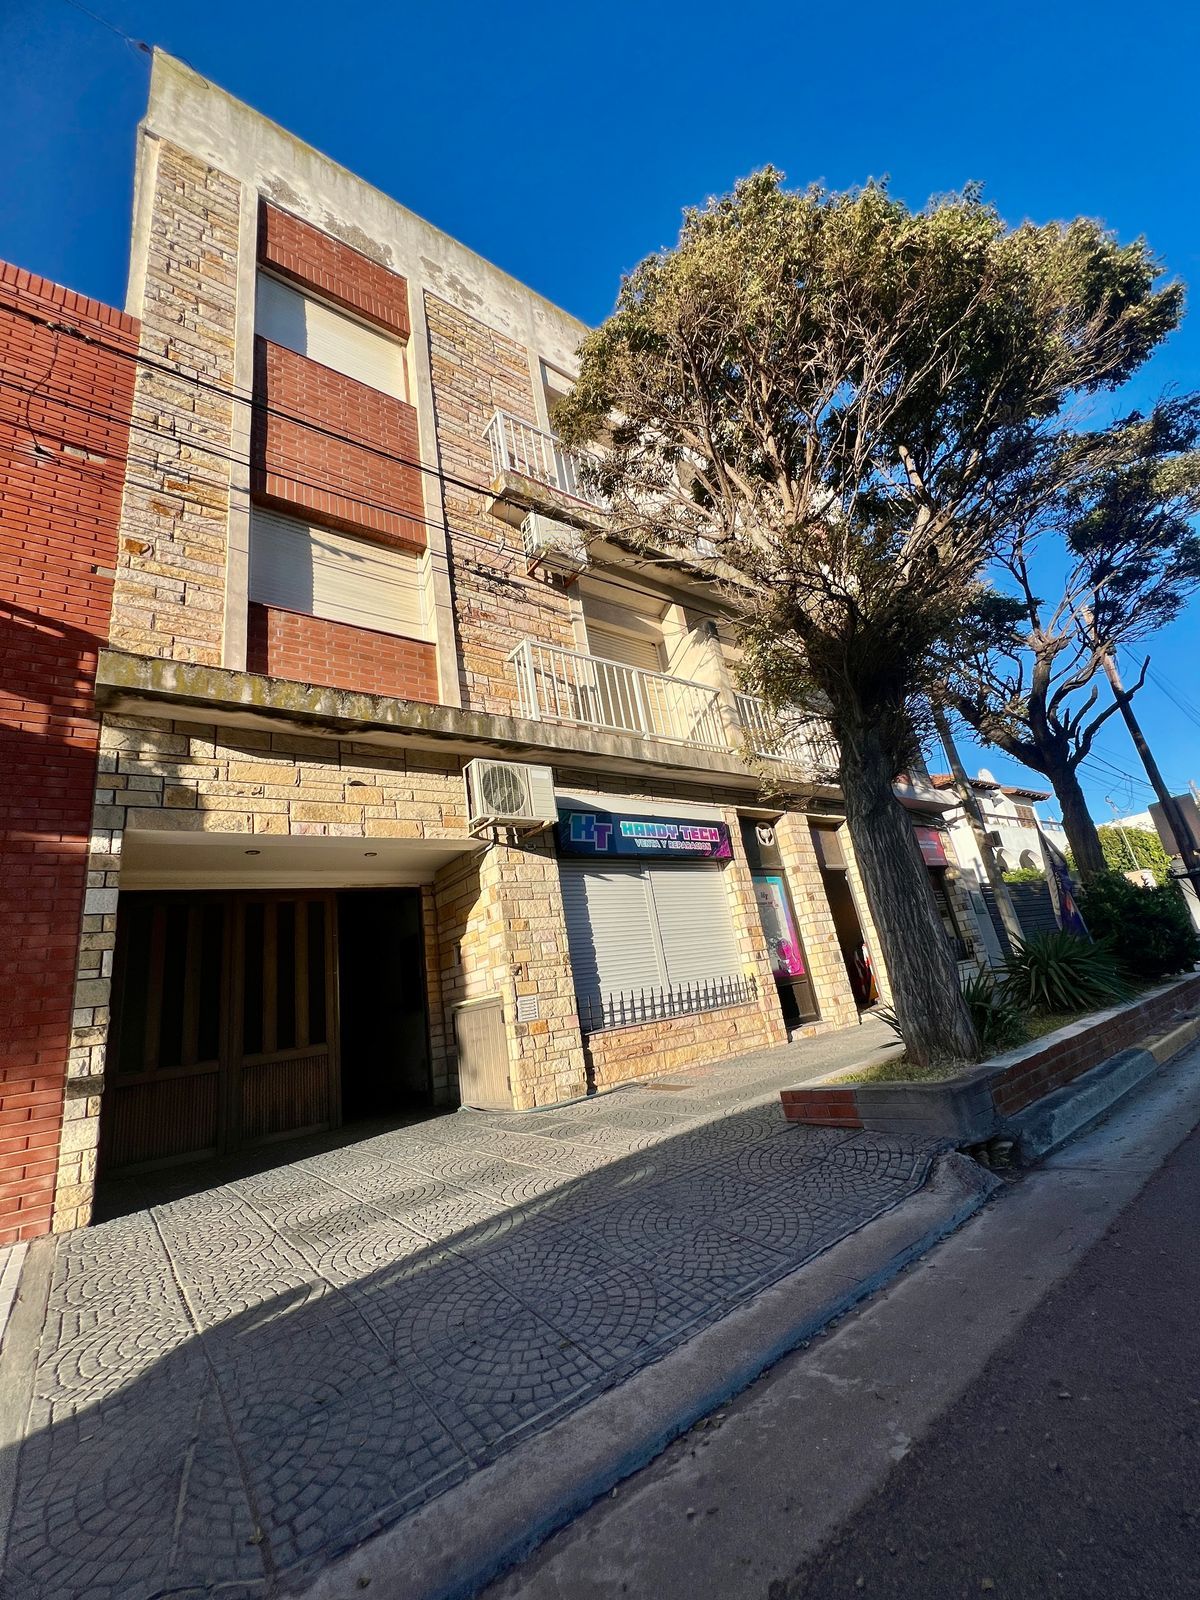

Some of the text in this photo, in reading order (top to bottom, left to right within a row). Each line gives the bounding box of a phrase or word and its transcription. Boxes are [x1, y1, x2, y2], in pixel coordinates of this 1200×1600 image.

[620, 821, 719, 842] HANDY TECH
[634, 839, 660, 848] VENTA
[660, 840, 667, 848] Y
